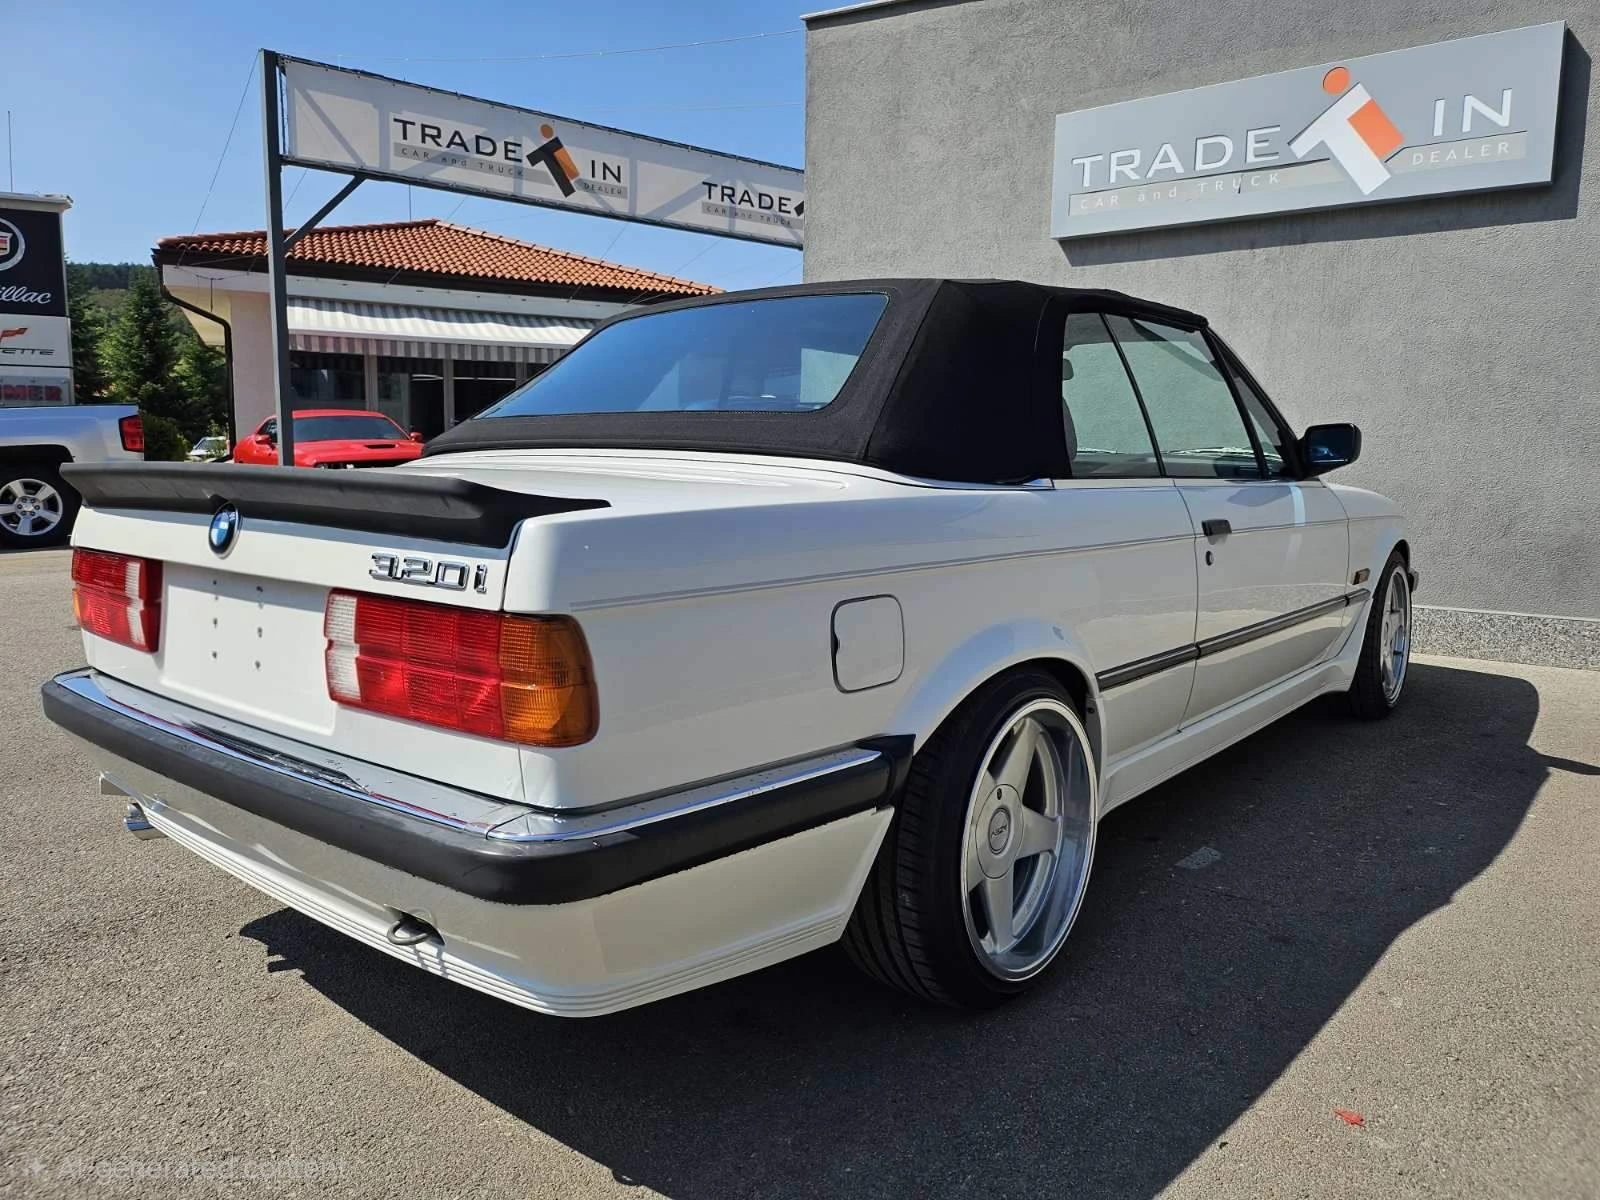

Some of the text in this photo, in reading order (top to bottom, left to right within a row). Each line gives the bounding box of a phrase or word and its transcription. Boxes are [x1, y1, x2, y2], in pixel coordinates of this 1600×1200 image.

[393, 118, 523, 163] TRADE
[591, 159, 622, 184] IN
[1071, 125, 1281, 188] TRADE
[1433, 87, 1512, 137] IN
[401, 148, 430, 159] CAR
[478, 161, 524, 176] TRUCK
[583, 182, 623, 195] DEALER
[1080, 142, 1510, 210] CAR and TRUCK DEALER
[702, 181, 791, 214] TRADE
[0, 383, 63, 402] MER
[369, 551, 488, 594] 320i
